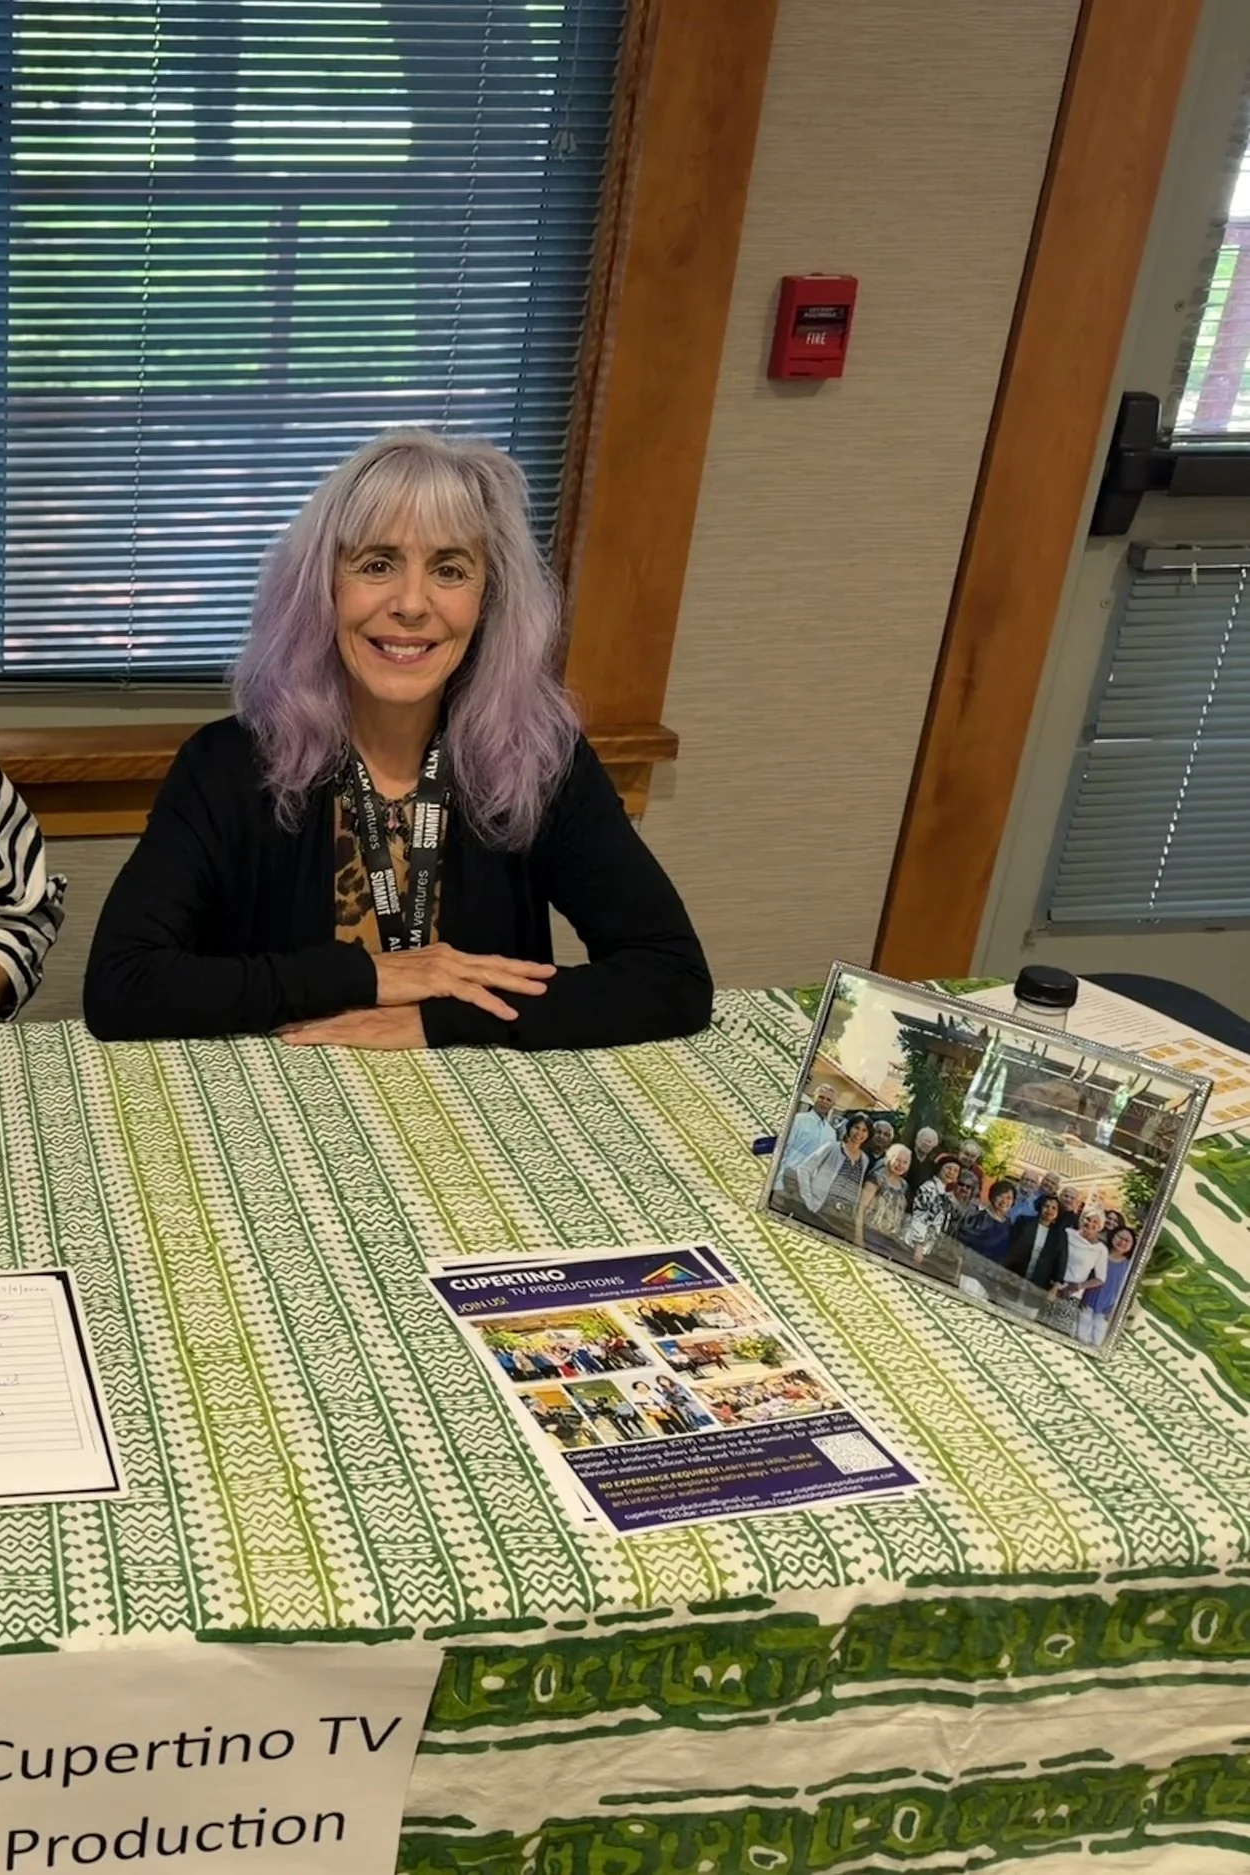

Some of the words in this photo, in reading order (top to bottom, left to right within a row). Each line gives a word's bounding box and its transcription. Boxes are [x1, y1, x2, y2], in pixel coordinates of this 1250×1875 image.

[806, 332, 827, 345] FIRE
[356, 761, 373, 792] ALM
[425, 749, 440, 780] ALM
[362, 794, 381, 850] ventures
[424, 802, 441, 849] SUMMIT
[369, 870, 391, 916] SUMMIT
[413, 869, 430, 927] ventures
[409, 929, 423, 950] LM
[450, 1269, 566, 1291] CUPERTINO
[508, 1287, 528, 1296] TV
[529, 1275, 625, 1294] PRODUCTIONS
[457, 1299, 488, 1314] JOIN
[486, 1296, 509, 1307] US!
[598, 1482, 613, 1490] NO
[615, 1474, 670, 1487] EXPERIENCE
[671, 1467, 720, 1479] REQUIRED!
[721, 1461, 745, 1471] Learn
[746, 1458, 763, 1467] new
[764, 1455, 789, 1465] skills,
[789, 1452, 812, 1461] make
[318, 1716, 403, 1756] TV
[5, 1808, 346, 1871] Production
